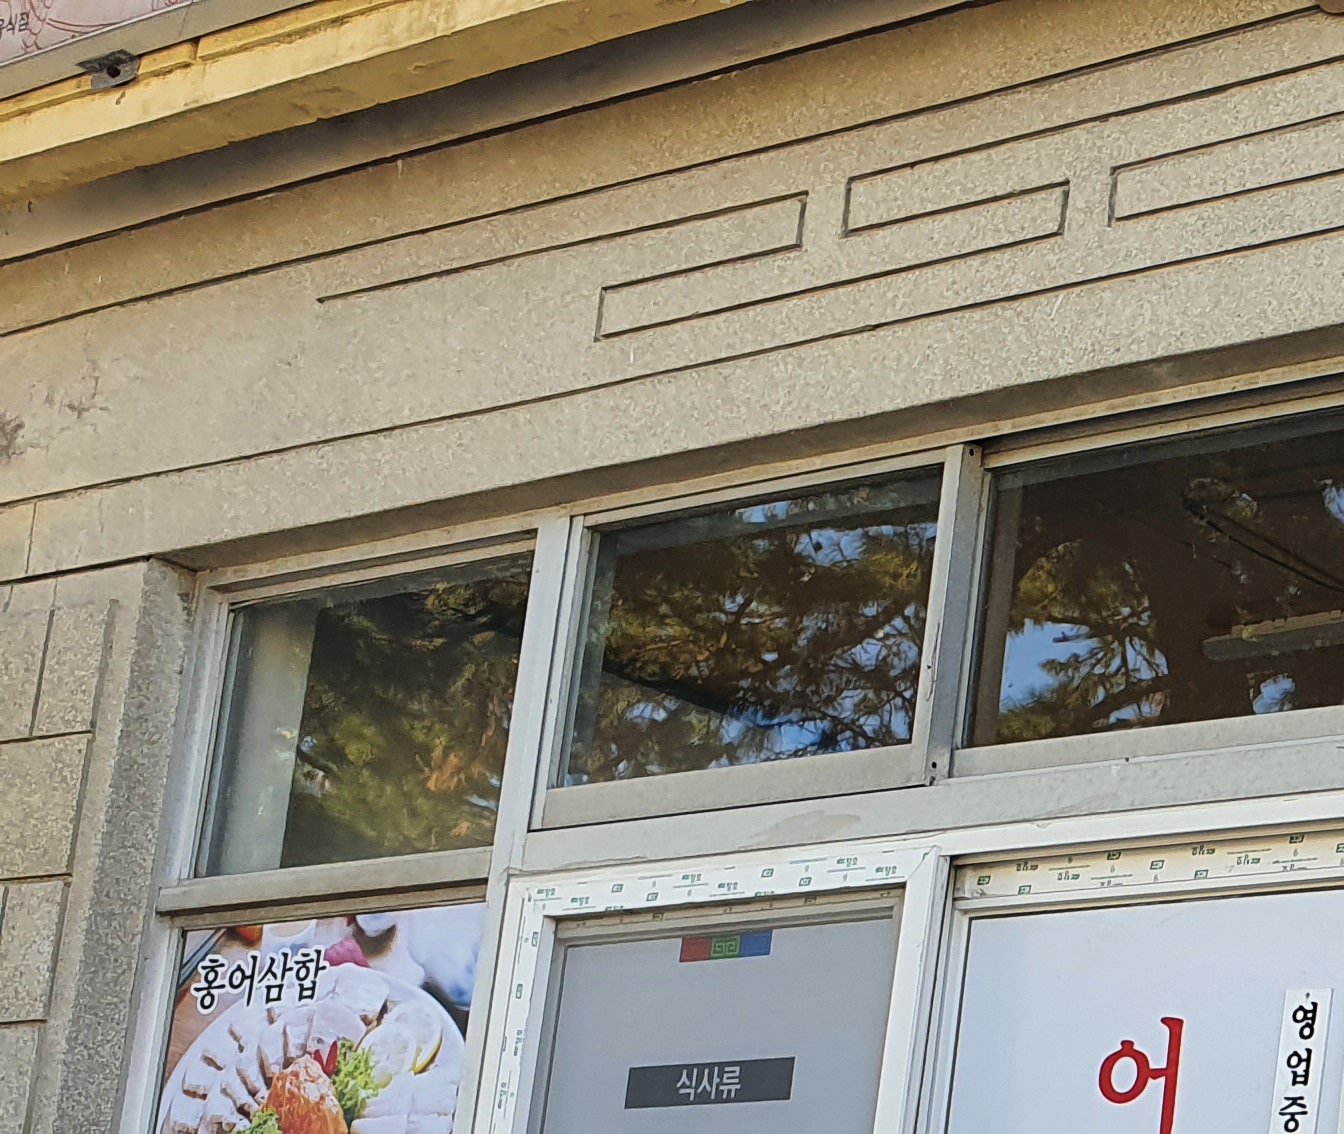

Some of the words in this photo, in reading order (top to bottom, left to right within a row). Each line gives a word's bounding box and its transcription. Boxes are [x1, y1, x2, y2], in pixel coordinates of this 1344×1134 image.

[194, 949, 326, 1009] 홍어삼합
[676, 1066, 742, 1101] 식사류
[1278, 1001, 1318, 1133] 영업중
